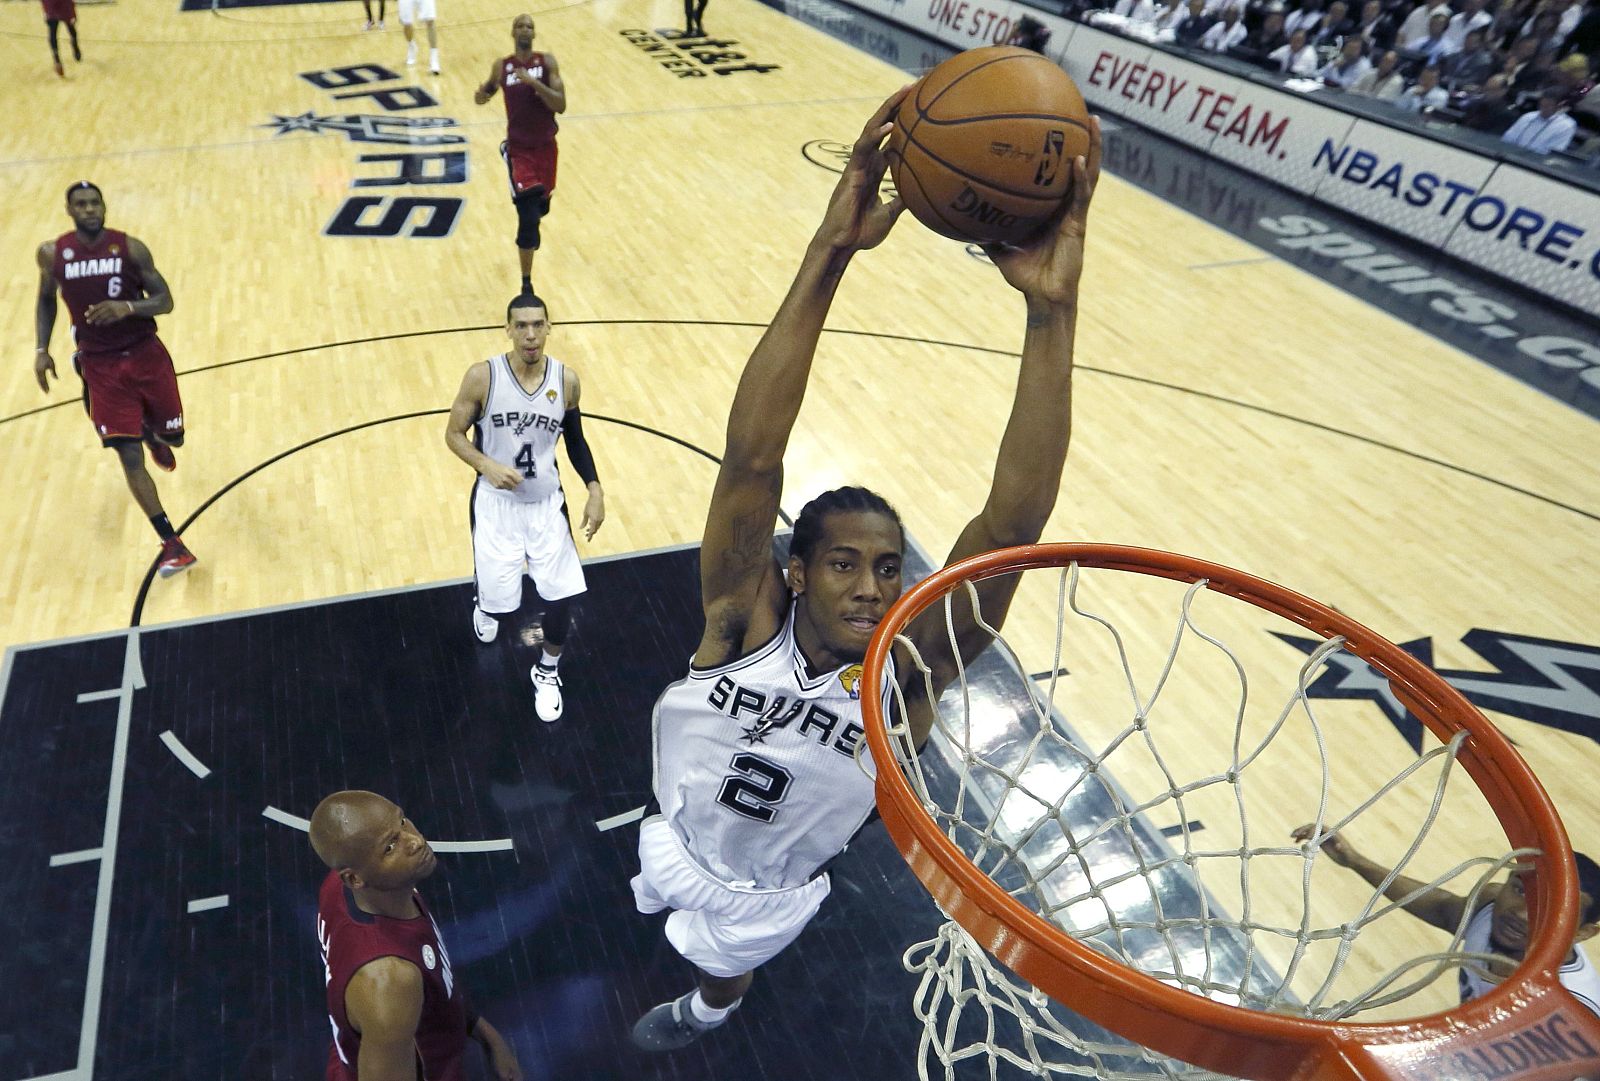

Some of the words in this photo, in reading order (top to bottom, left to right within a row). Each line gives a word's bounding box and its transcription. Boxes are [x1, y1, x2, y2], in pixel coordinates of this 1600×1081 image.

[926, 0, 969, 31] ONE
[619, 28, 708, 79] CENTER
[1088, 51, 1188, 113] EVERY
[1186, 86, 1291, 161] TEAM.
[290, 63, 470, 239] SPURS
[1312, 138, 1600, 281] NBASTORE.
[64, 257, 123, 280] MIAMI
[107, 276, 122, 298] 6
[491, 411, 560, 436] SPURS
[513, 442, 537, 479] 4
[715, 752, 795, 824] 2
[1415, 1012, 1599, 1081] ALDING
